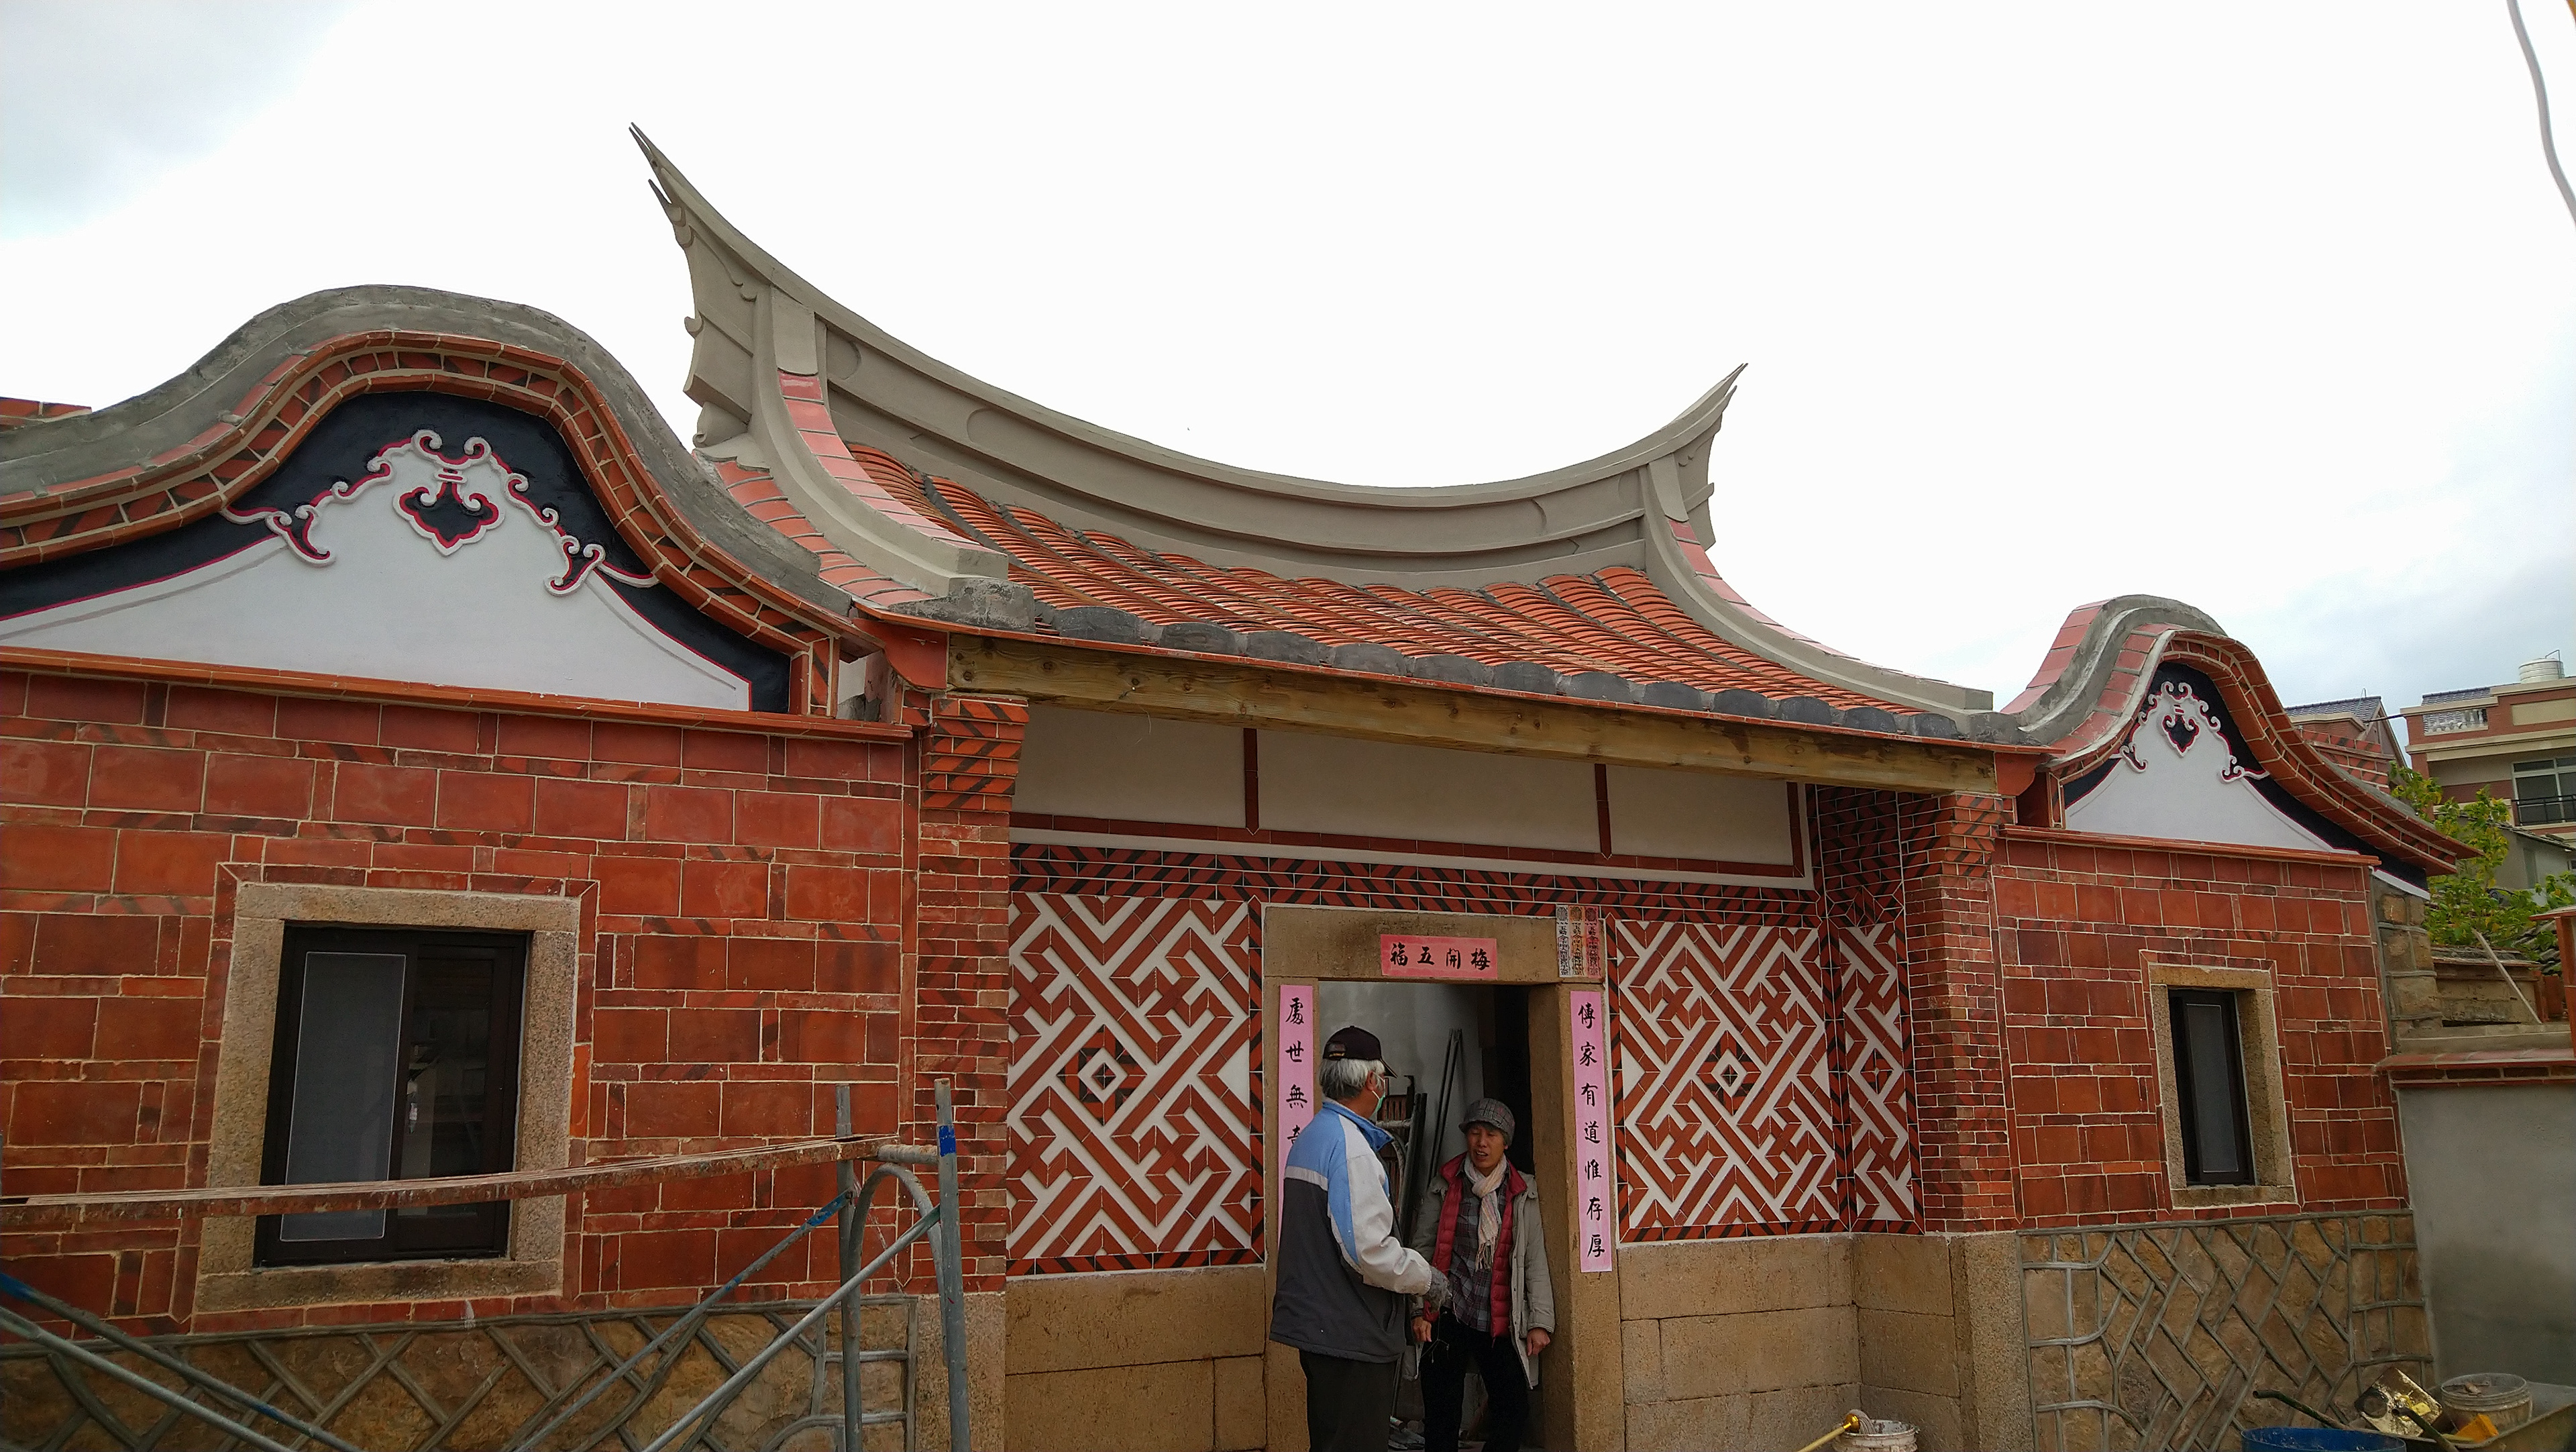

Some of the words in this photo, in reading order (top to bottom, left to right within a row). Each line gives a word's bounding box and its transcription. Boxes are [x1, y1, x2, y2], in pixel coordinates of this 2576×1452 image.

[1578, 1002, 1605, 1258] 傳家有道惟存厚
